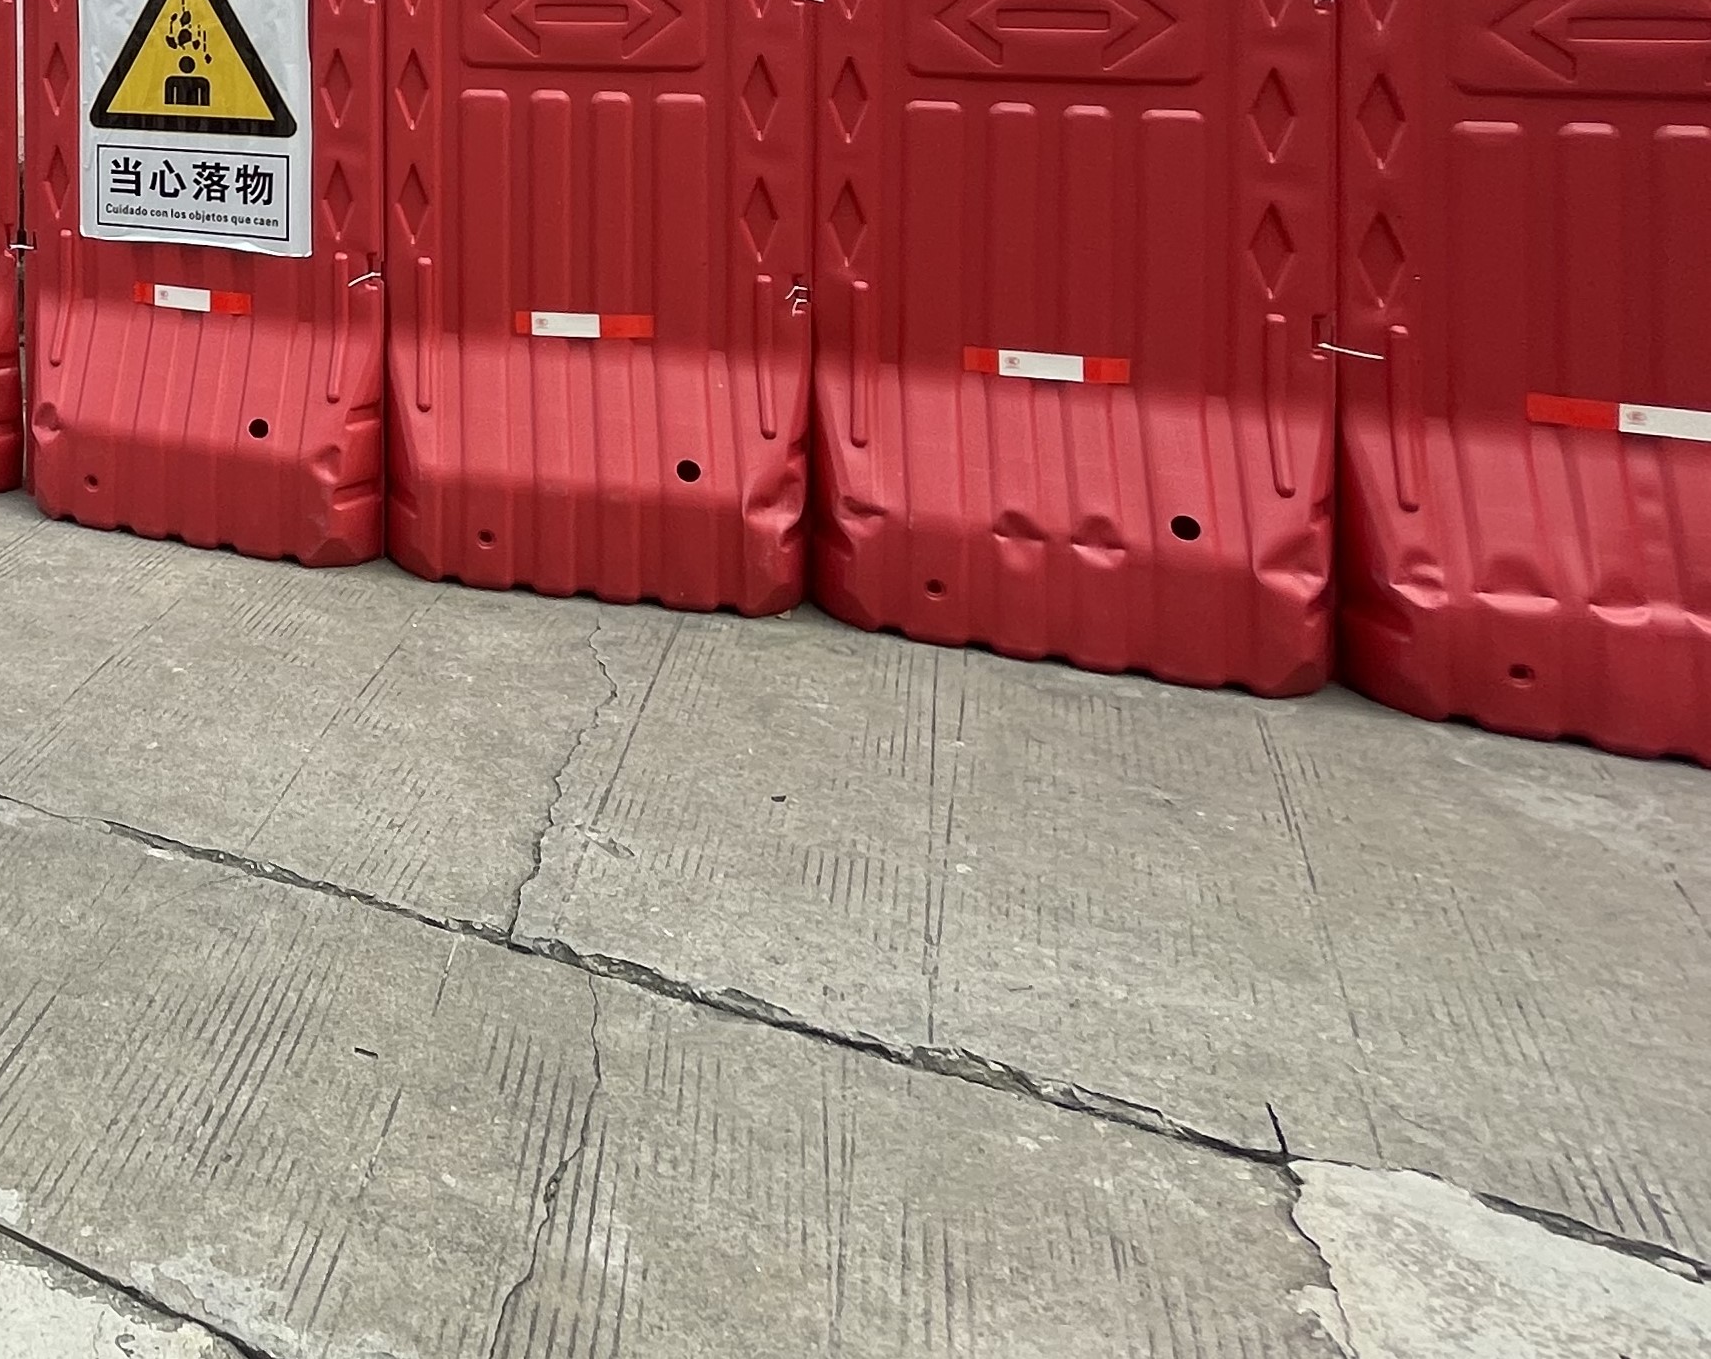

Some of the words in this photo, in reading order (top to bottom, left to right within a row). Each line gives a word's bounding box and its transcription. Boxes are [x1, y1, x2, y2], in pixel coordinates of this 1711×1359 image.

[110, 157, 274, 205] 当心落物
[105, 203, 148, 216] Cuidado
[150, 208, 169, 218] con
[171, 209, 186, 220] los
[188, 210, 228, 224] objetos
[231, 215, 251, 226] que
[253, 217, 279, 228] caen
